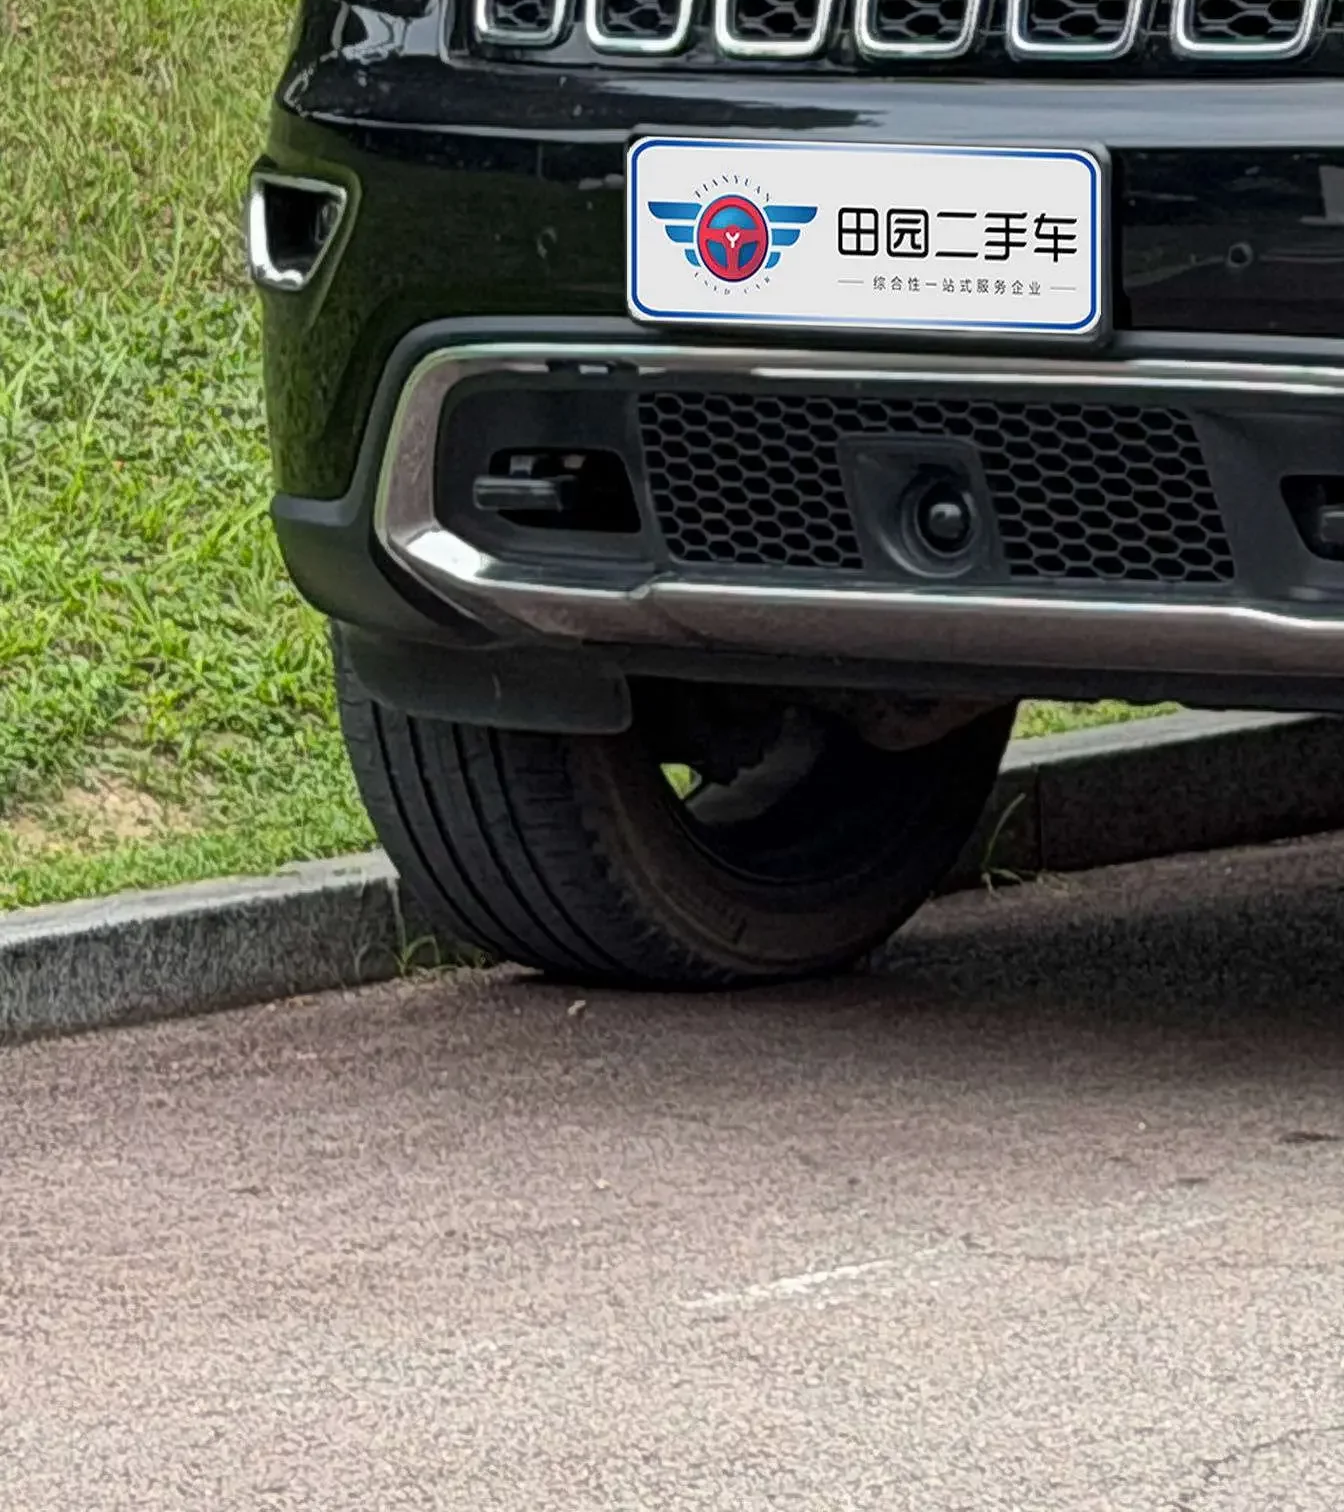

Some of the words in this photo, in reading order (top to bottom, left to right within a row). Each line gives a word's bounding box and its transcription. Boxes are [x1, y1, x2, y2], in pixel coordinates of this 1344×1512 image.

[838, 207, 1077, 263] 田园二手车
[873, 275, 1041, 296] 综合性一站式服务企业
